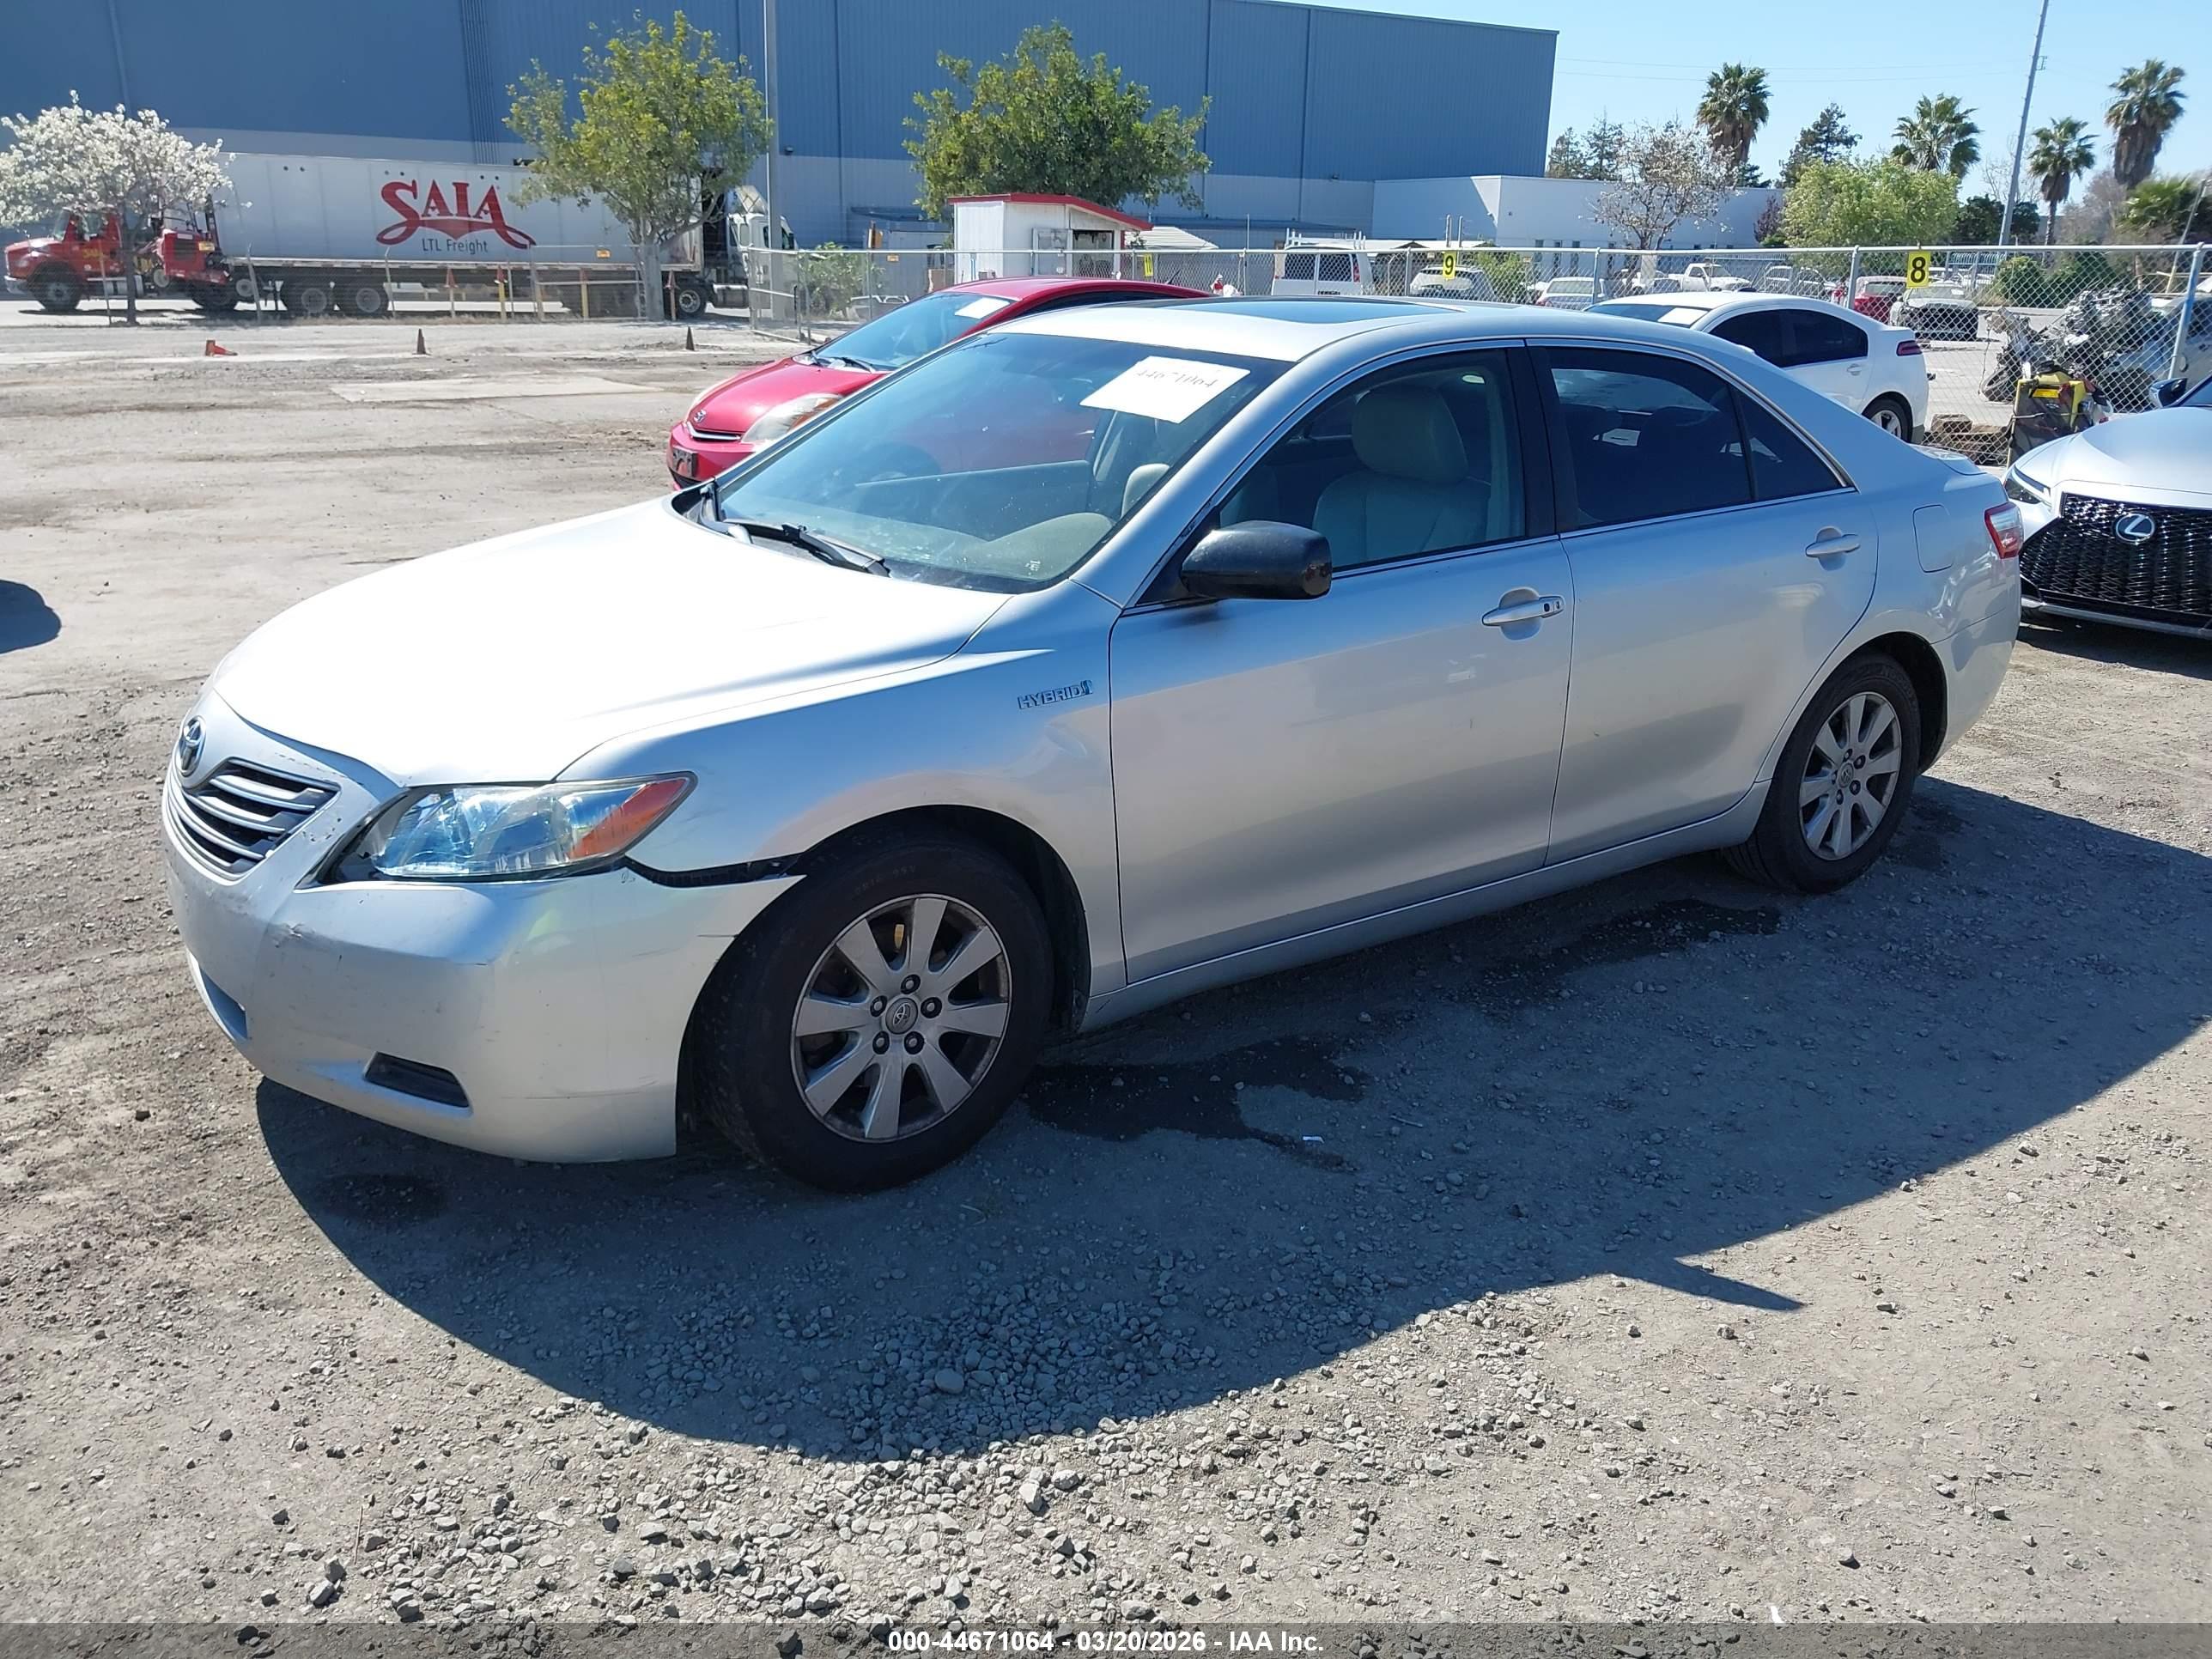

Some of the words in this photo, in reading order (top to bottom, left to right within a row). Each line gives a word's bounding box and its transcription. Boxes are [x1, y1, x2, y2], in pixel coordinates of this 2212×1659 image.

[376, 179, 537, 250] SAIA
[422, 238, 442, 252] LTL
[447, 239, 489, 254] Freight
[1445, 255, 1454, 275] 9
[1911, 257, 1926, 283] 8
[1017, 684, 1084, 709] HYBRID
